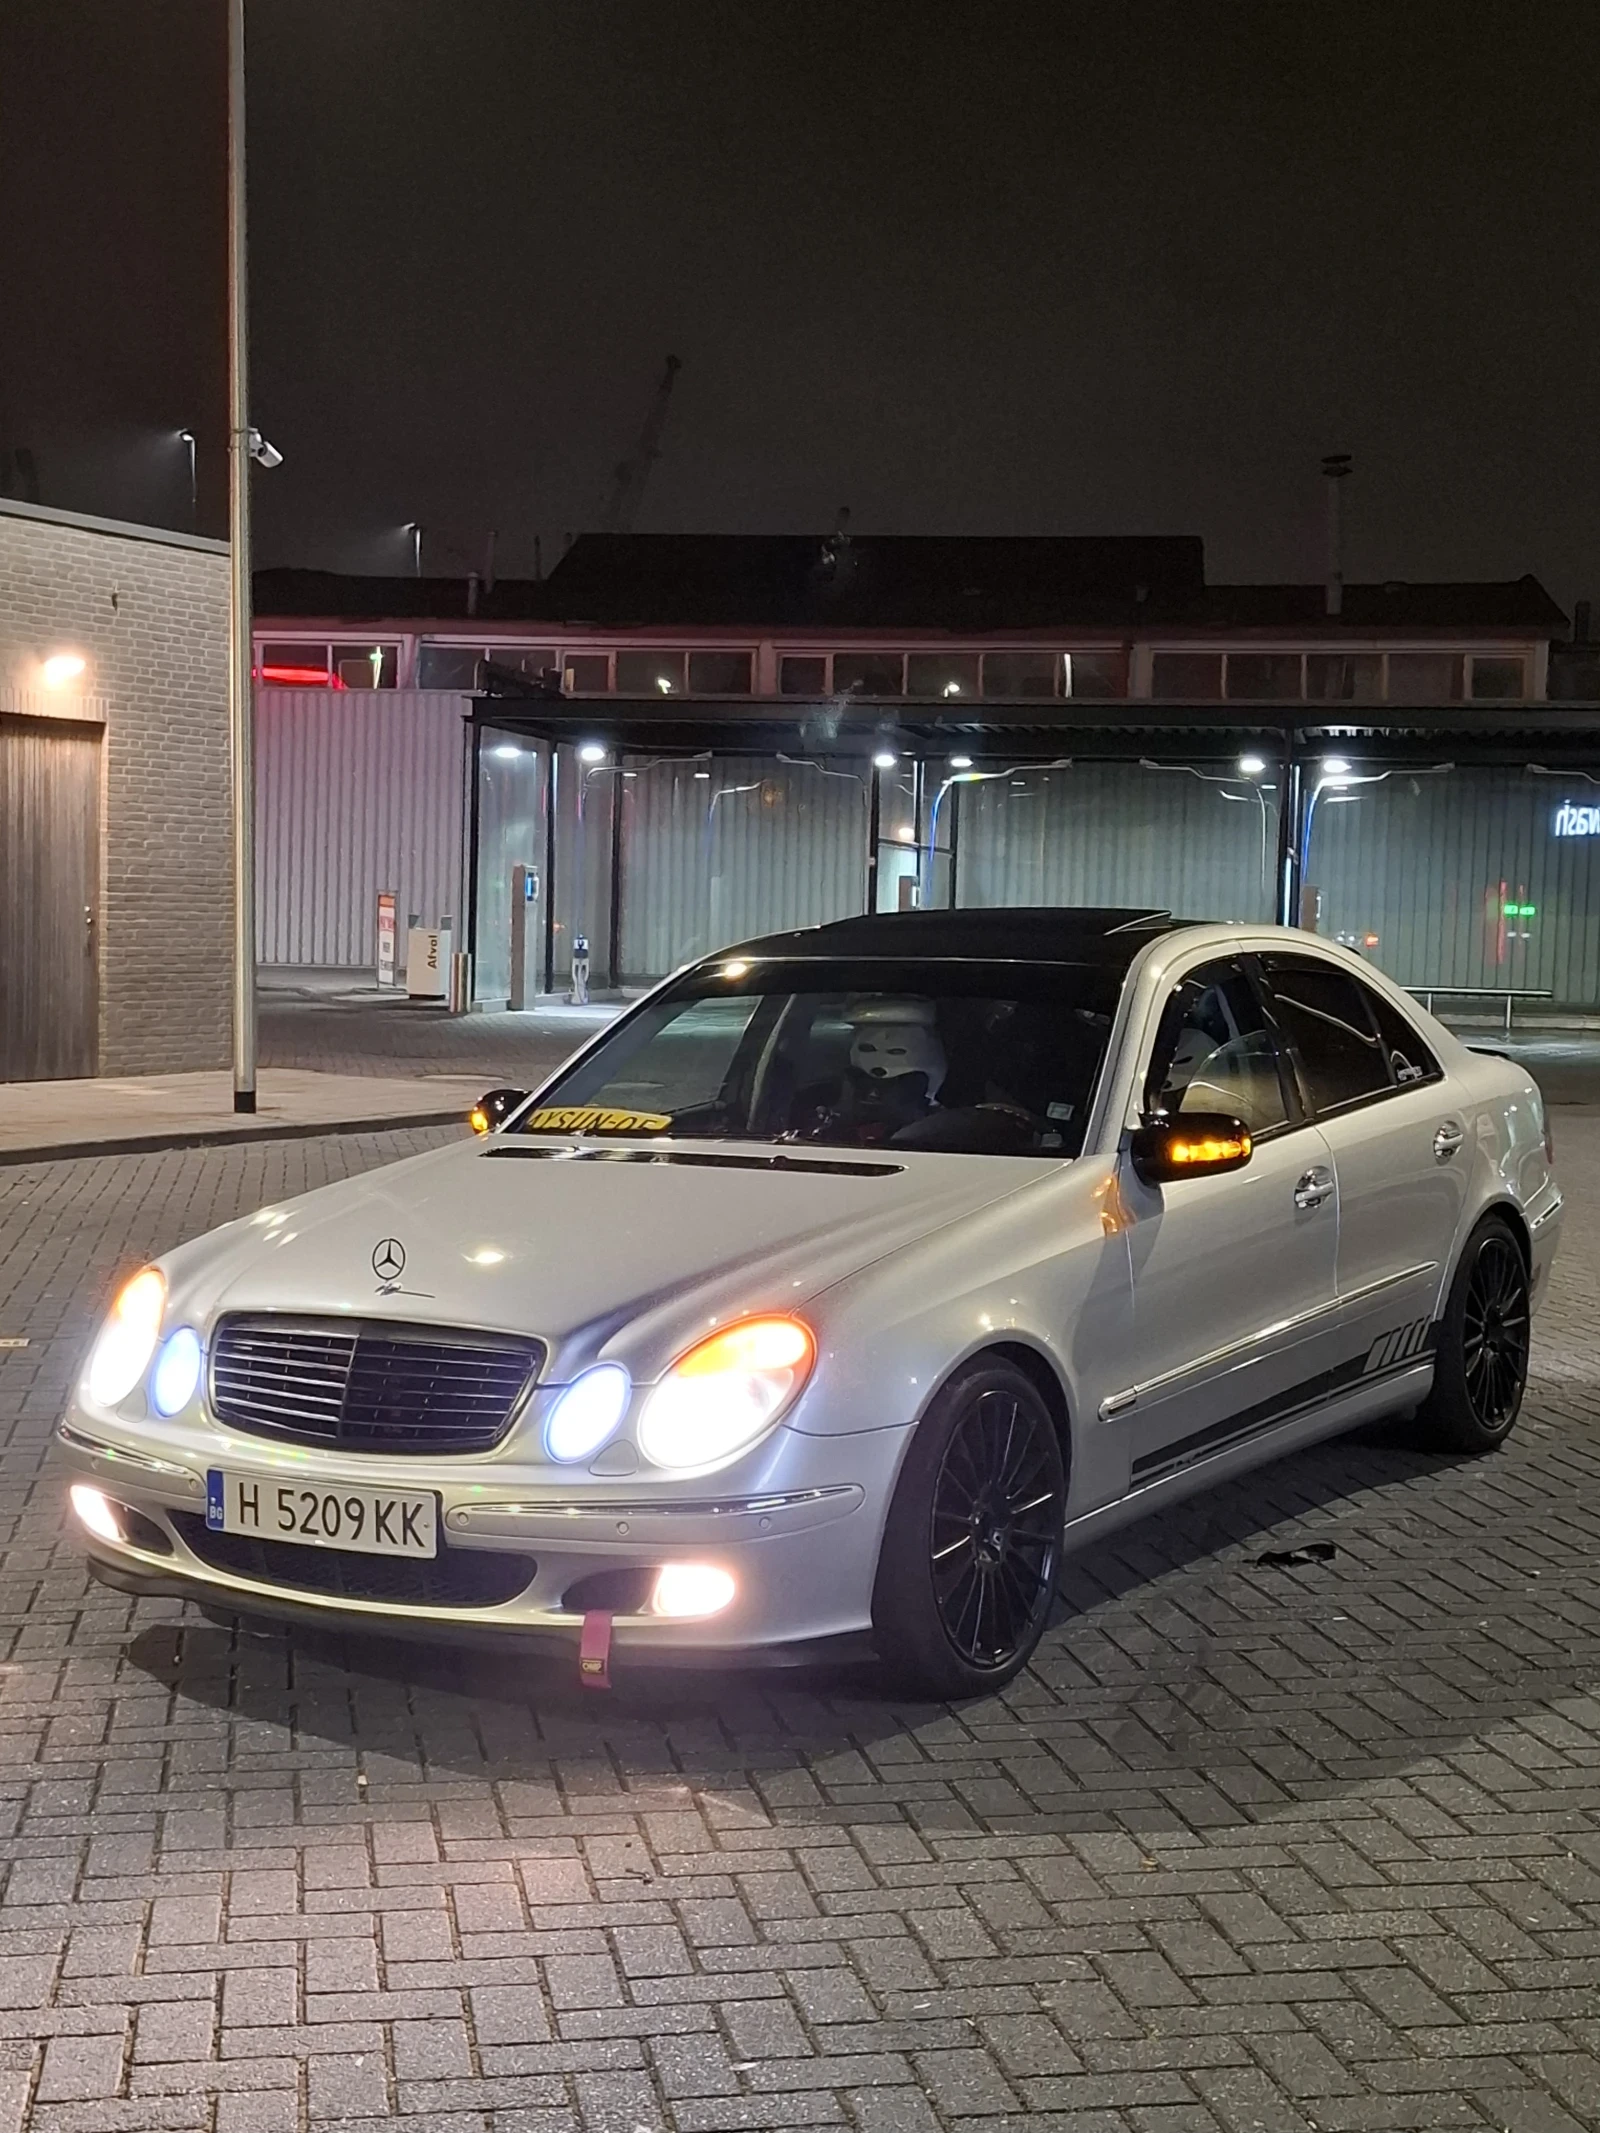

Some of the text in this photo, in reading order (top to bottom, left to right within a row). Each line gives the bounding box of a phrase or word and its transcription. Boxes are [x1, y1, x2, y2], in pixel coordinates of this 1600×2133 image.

[209, 1506, 223, 1520] BG
[239, 1482, 426, 1547] H 5209 KK
